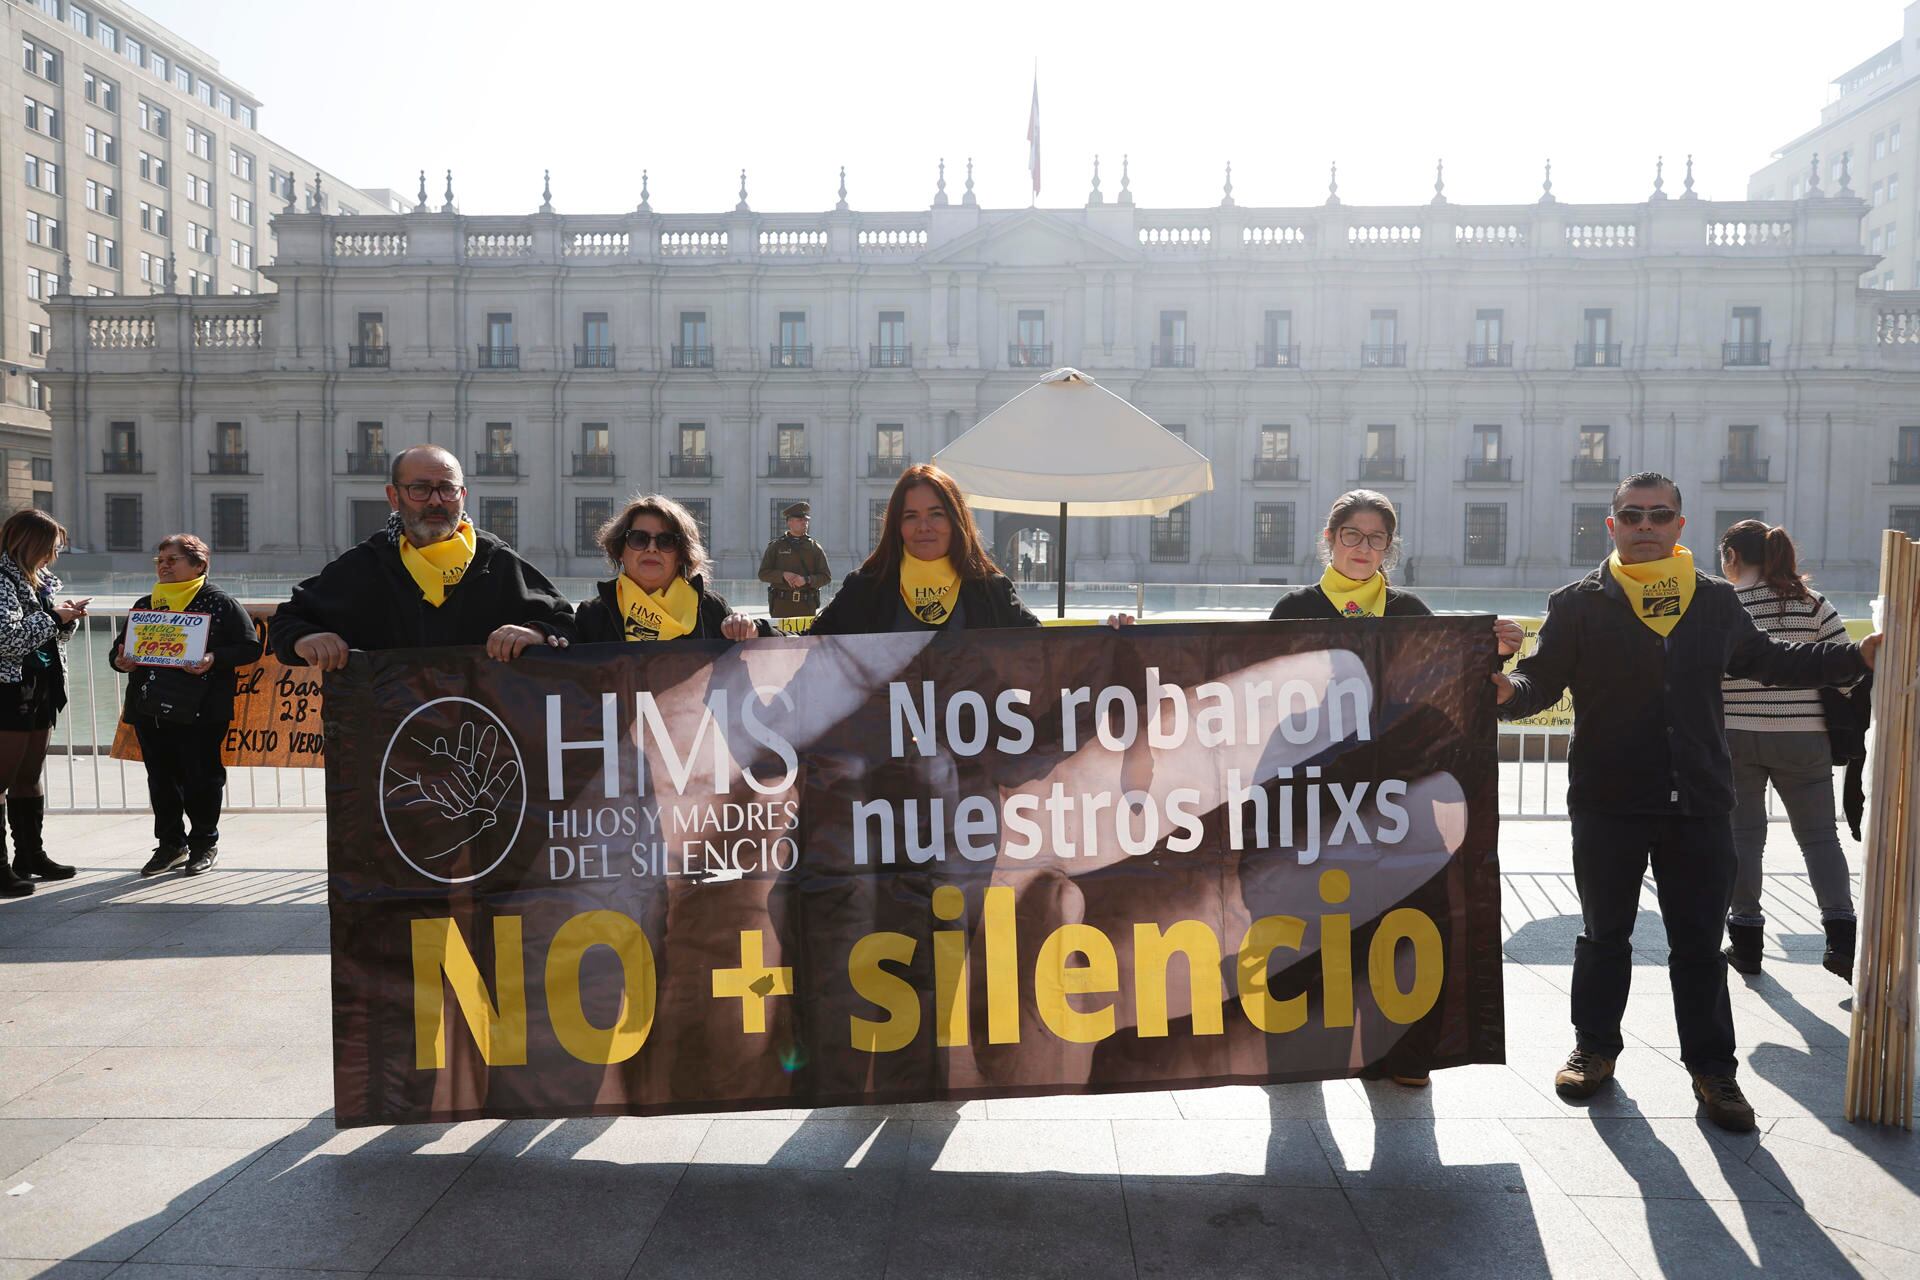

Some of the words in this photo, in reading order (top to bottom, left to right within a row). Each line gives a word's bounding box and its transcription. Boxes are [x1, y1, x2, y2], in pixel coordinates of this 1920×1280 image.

[631, 602, 663, 625] HMS
[137, 641, 184, 656] 1979
[889, 680, 1035, 758] Nos
[1061, 666, 1372, 752] robaron
[226, 729, 278, 753] EXIJO
[545, 685, 799, 801] HMS
[548, 806, 636, 839] HIJOS
[643, 806, 662, 836] Y
[672, 801, 799, 836] MADRES
[851, 782, 1204, 865] nuestros
[1227, 766, 1409, 864] hijxs
[549, 844, 621, 880] DEL
[631, 836, 799, 878] SILENCIO
[410, 909, 657, 1070] NO
[712, 930, 794, 1034] +
[848, 869, 1445, 1053] silencio
